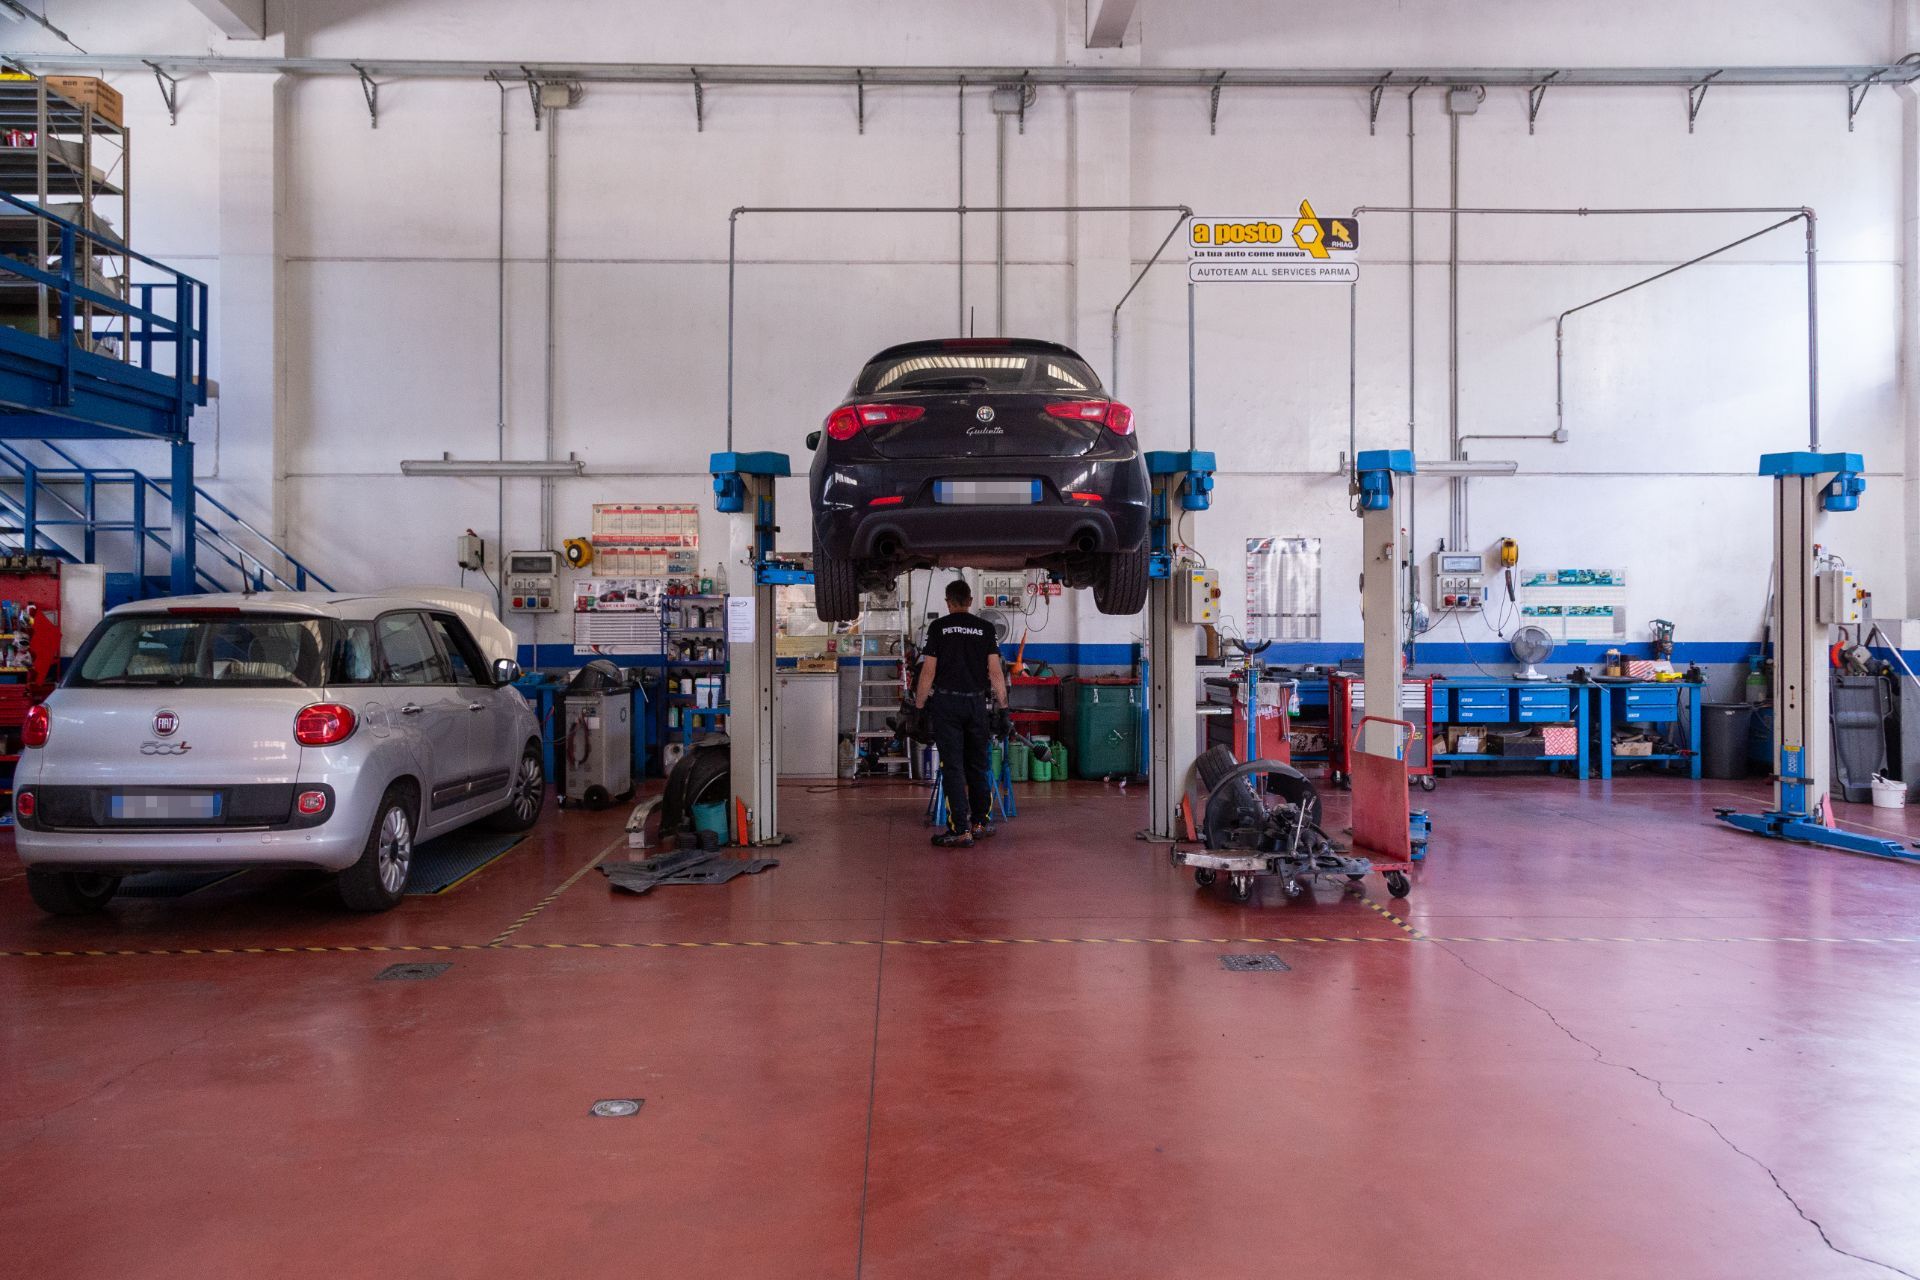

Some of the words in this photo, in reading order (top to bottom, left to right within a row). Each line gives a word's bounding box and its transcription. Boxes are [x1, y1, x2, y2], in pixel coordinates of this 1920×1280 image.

[1193, 223, 1210, 243] a
[1214, 222, 1283, 245] posto
[1197, 268, 1248, 276] AUTOTEAM
[1251, 268, 1269, 276] ALL
[1271, 268, 1317, 276] SERVICES
[1319, 268, 1351, 276] PARMA
[966, 426, 1004, 436] Giulietta
[942, 626, 984, 636] PETRONAS
[158, 717, 173, 729] FIAT
